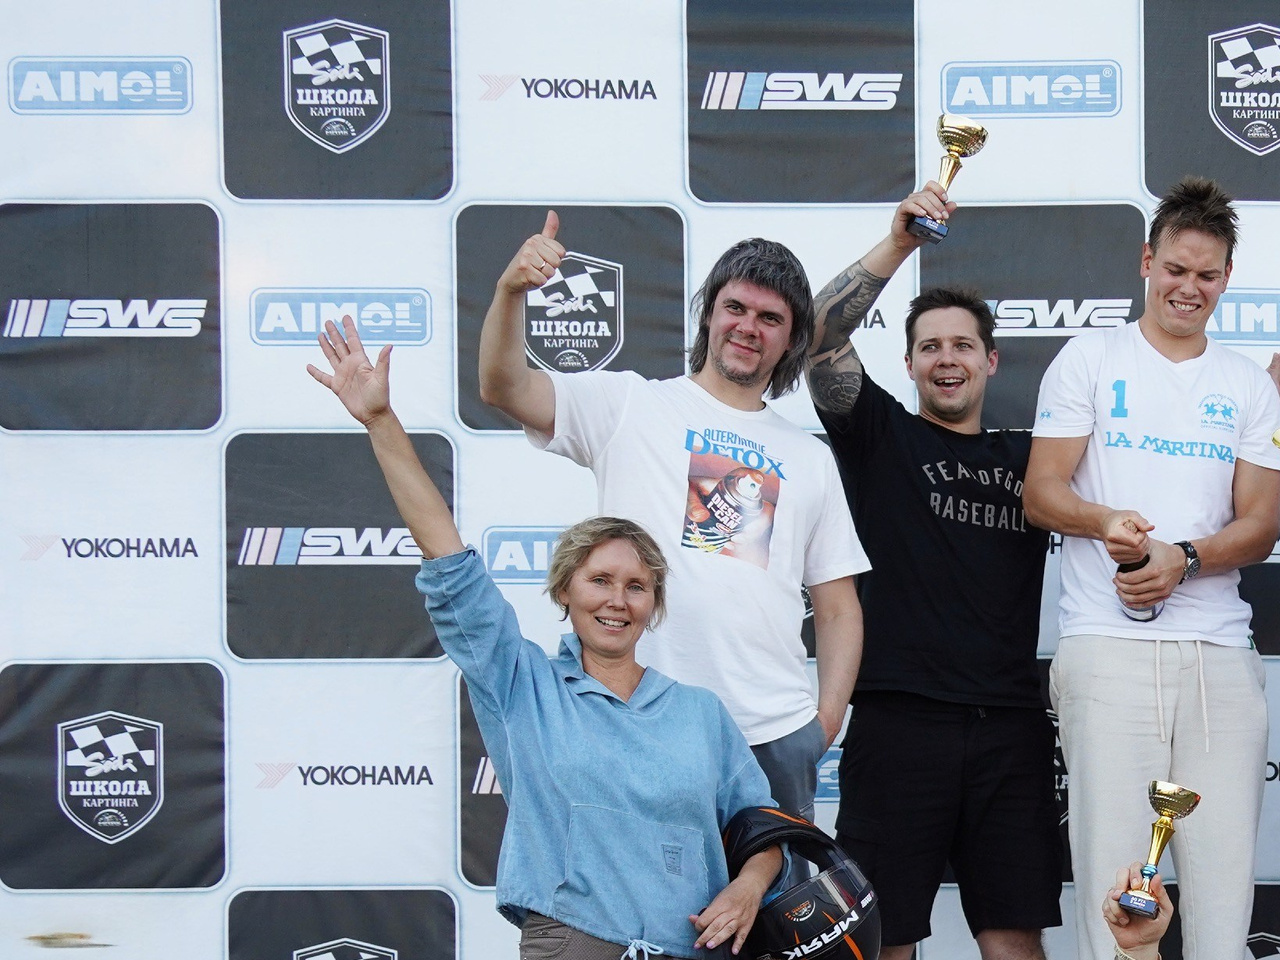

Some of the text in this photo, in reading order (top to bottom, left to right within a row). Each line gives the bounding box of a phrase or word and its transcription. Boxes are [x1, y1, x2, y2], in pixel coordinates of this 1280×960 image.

[18, 70, 183, 102] AIMOL
[296, 88, 378, 105] ШКОЛА
[521, 79, 657, 99] YOKOHAMA
[762, 73, 903, 110] SWS
[951, 74, 1111, 105] AIMOL
[310, 107, 366, 117] КАРТИНГА
[62, 300, 207, 337] SWS
[530, 320, 611, 337] ШКОЛА
[993, 299, 1132, 337] SWS
[544, 338, 599, 348] КАРТИНГА
[1110, 379, 1129, 418] 1
[684, 428, 788, 481] DETOX
[1104, 431, 1235, 464] LA MARTINA
[711, 493, 744, 524] DIESEL
[929, 491, 1027, 533] BASEBALL
[62, 538, 198, 558] YOKOHAMA
[69, 780, 152, 796] ШКОЛА
[298, 766, 433, 785] YOKOHAMA
[82, 798, 138, 808] КАРТИНГА
